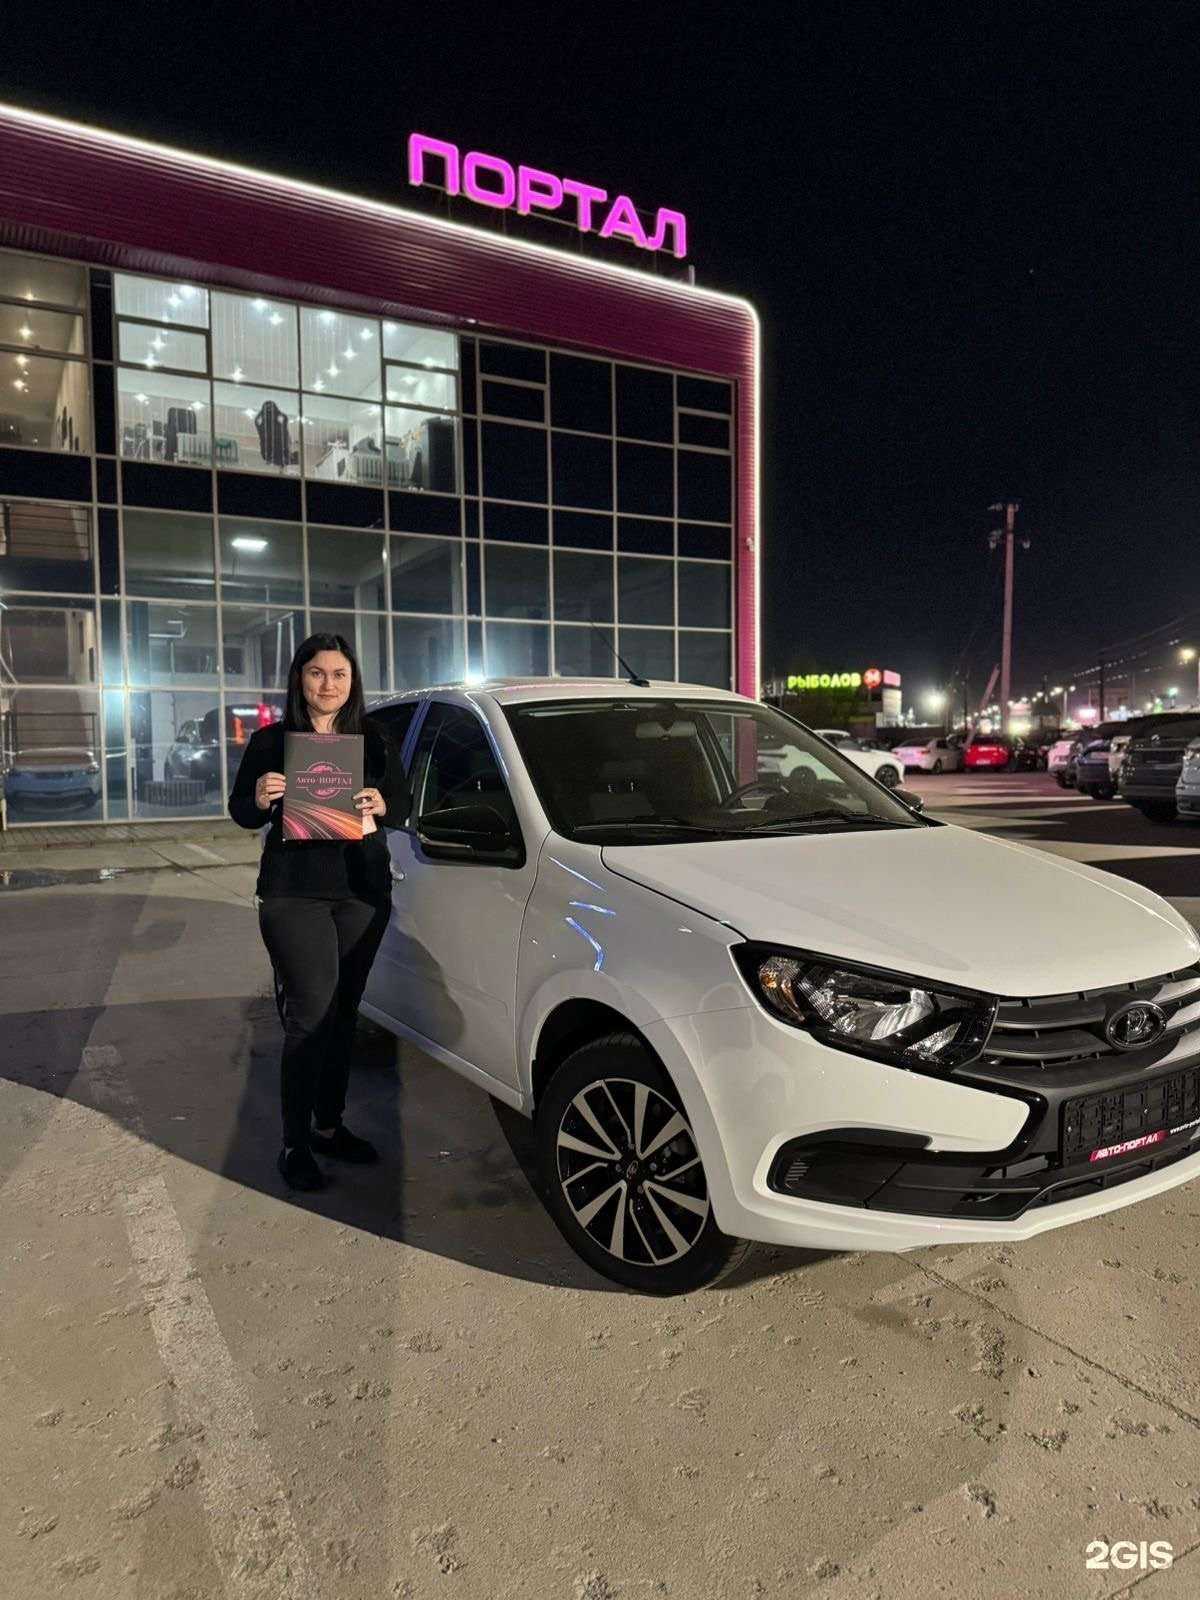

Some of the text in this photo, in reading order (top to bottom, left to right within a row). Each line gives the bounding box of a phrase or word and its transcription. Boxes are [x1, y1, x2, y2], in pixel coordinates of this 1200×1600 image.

[408, 132, 687, 258] ПОРТАЛ
[787, 672, 861, 689] РЫБОЛОВ
[1094, 1132, 1158, 1160] АВТО-ПОРТАЛ
